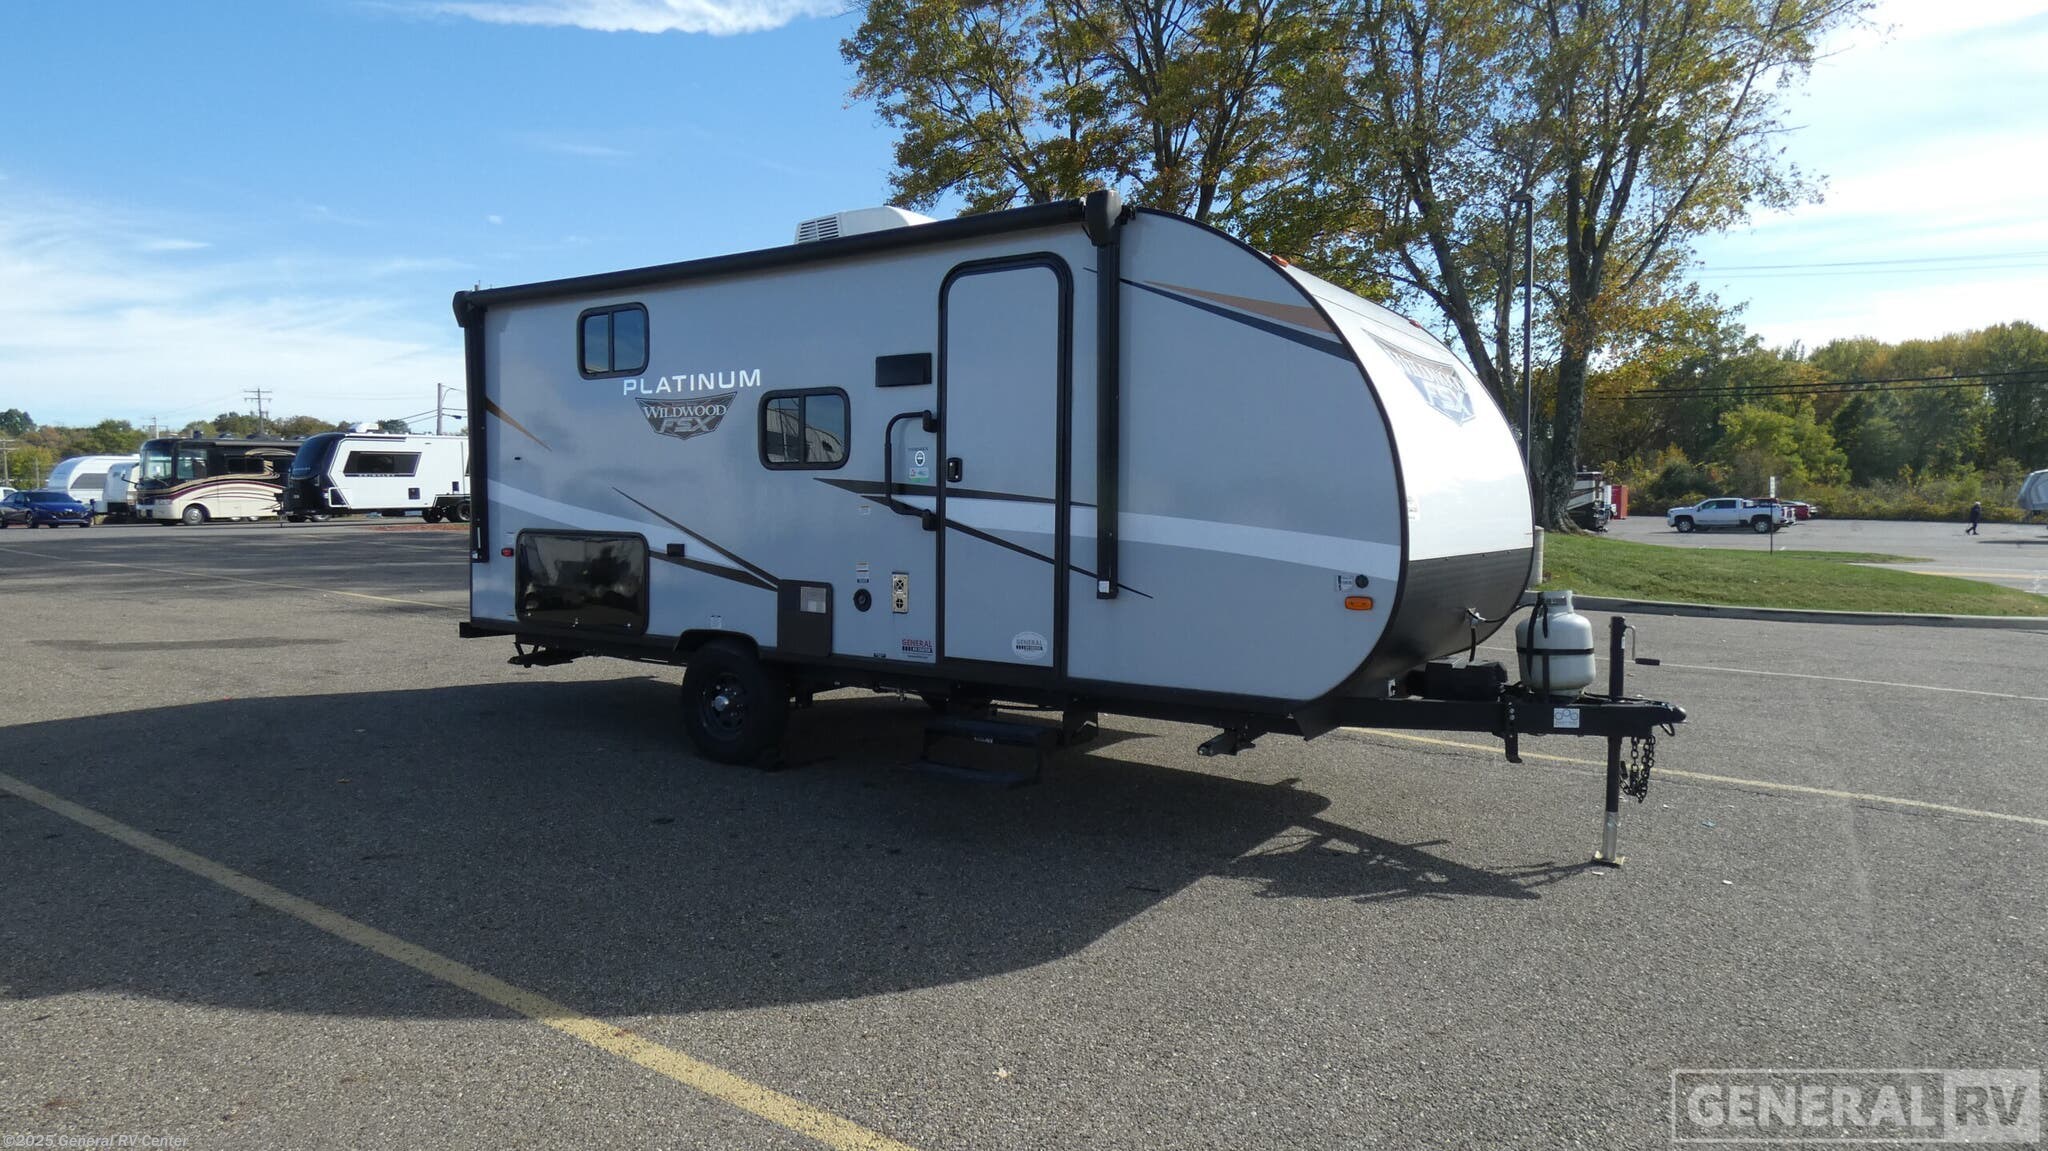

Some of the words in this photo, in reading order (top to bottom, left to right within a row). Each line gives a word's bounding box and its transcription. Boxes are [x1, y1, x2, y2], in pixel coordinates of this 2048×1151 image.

[624, 369, 761, 395] PLATINUM
[644, 404, 727, 419] WILDWOOD
[660, 417, 711, 433] FSX
